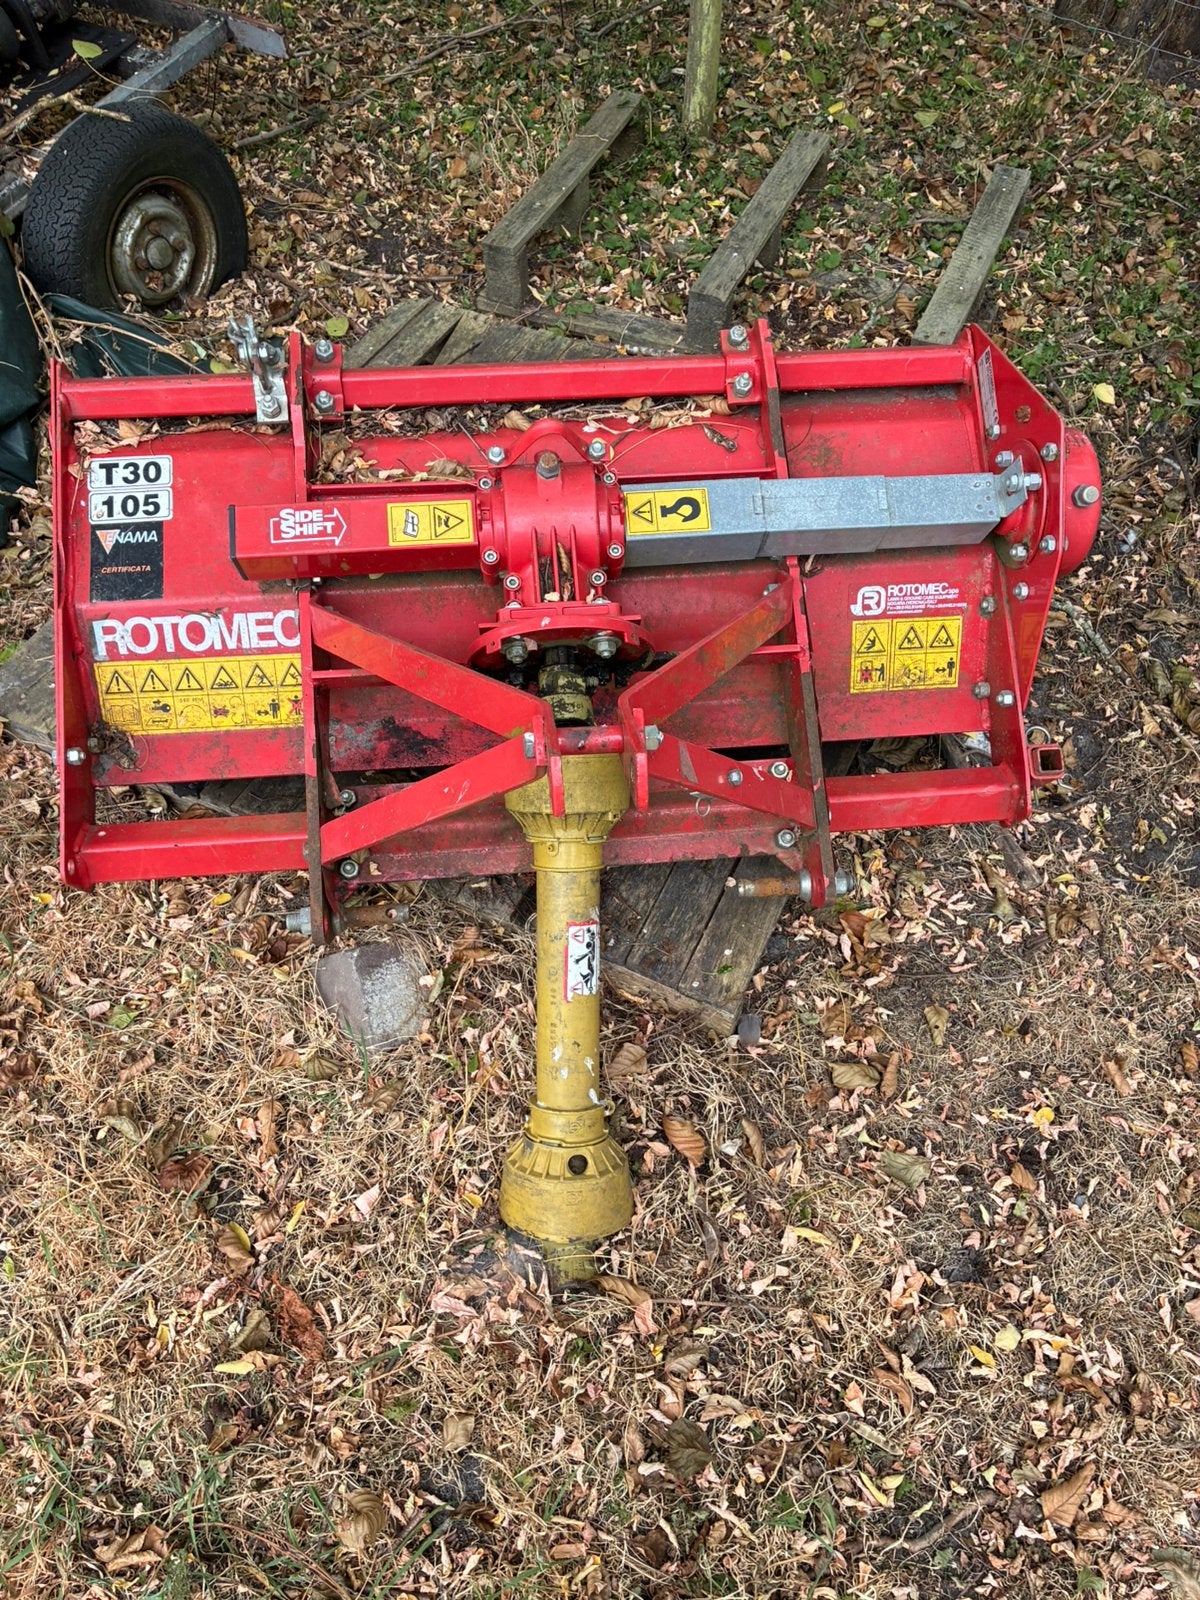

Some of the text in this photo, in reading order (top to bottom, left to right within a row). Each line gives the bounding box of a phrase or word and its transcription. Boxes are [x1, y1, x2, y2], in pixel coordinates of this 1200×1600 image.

[99, 461, 162, 485] T30
[102, 493, 161, 518] 105
[279, 508, 323, 524] SIDE
[105, 529, 158, 545] ENAMA
[280, 521, 335, 538] SHIFT
[101, 565, 151, 574] CERTIFICATA
[887, 582, 949, 597] ROTOMEC
[92, 609, 301, 656] ROTOMEC
